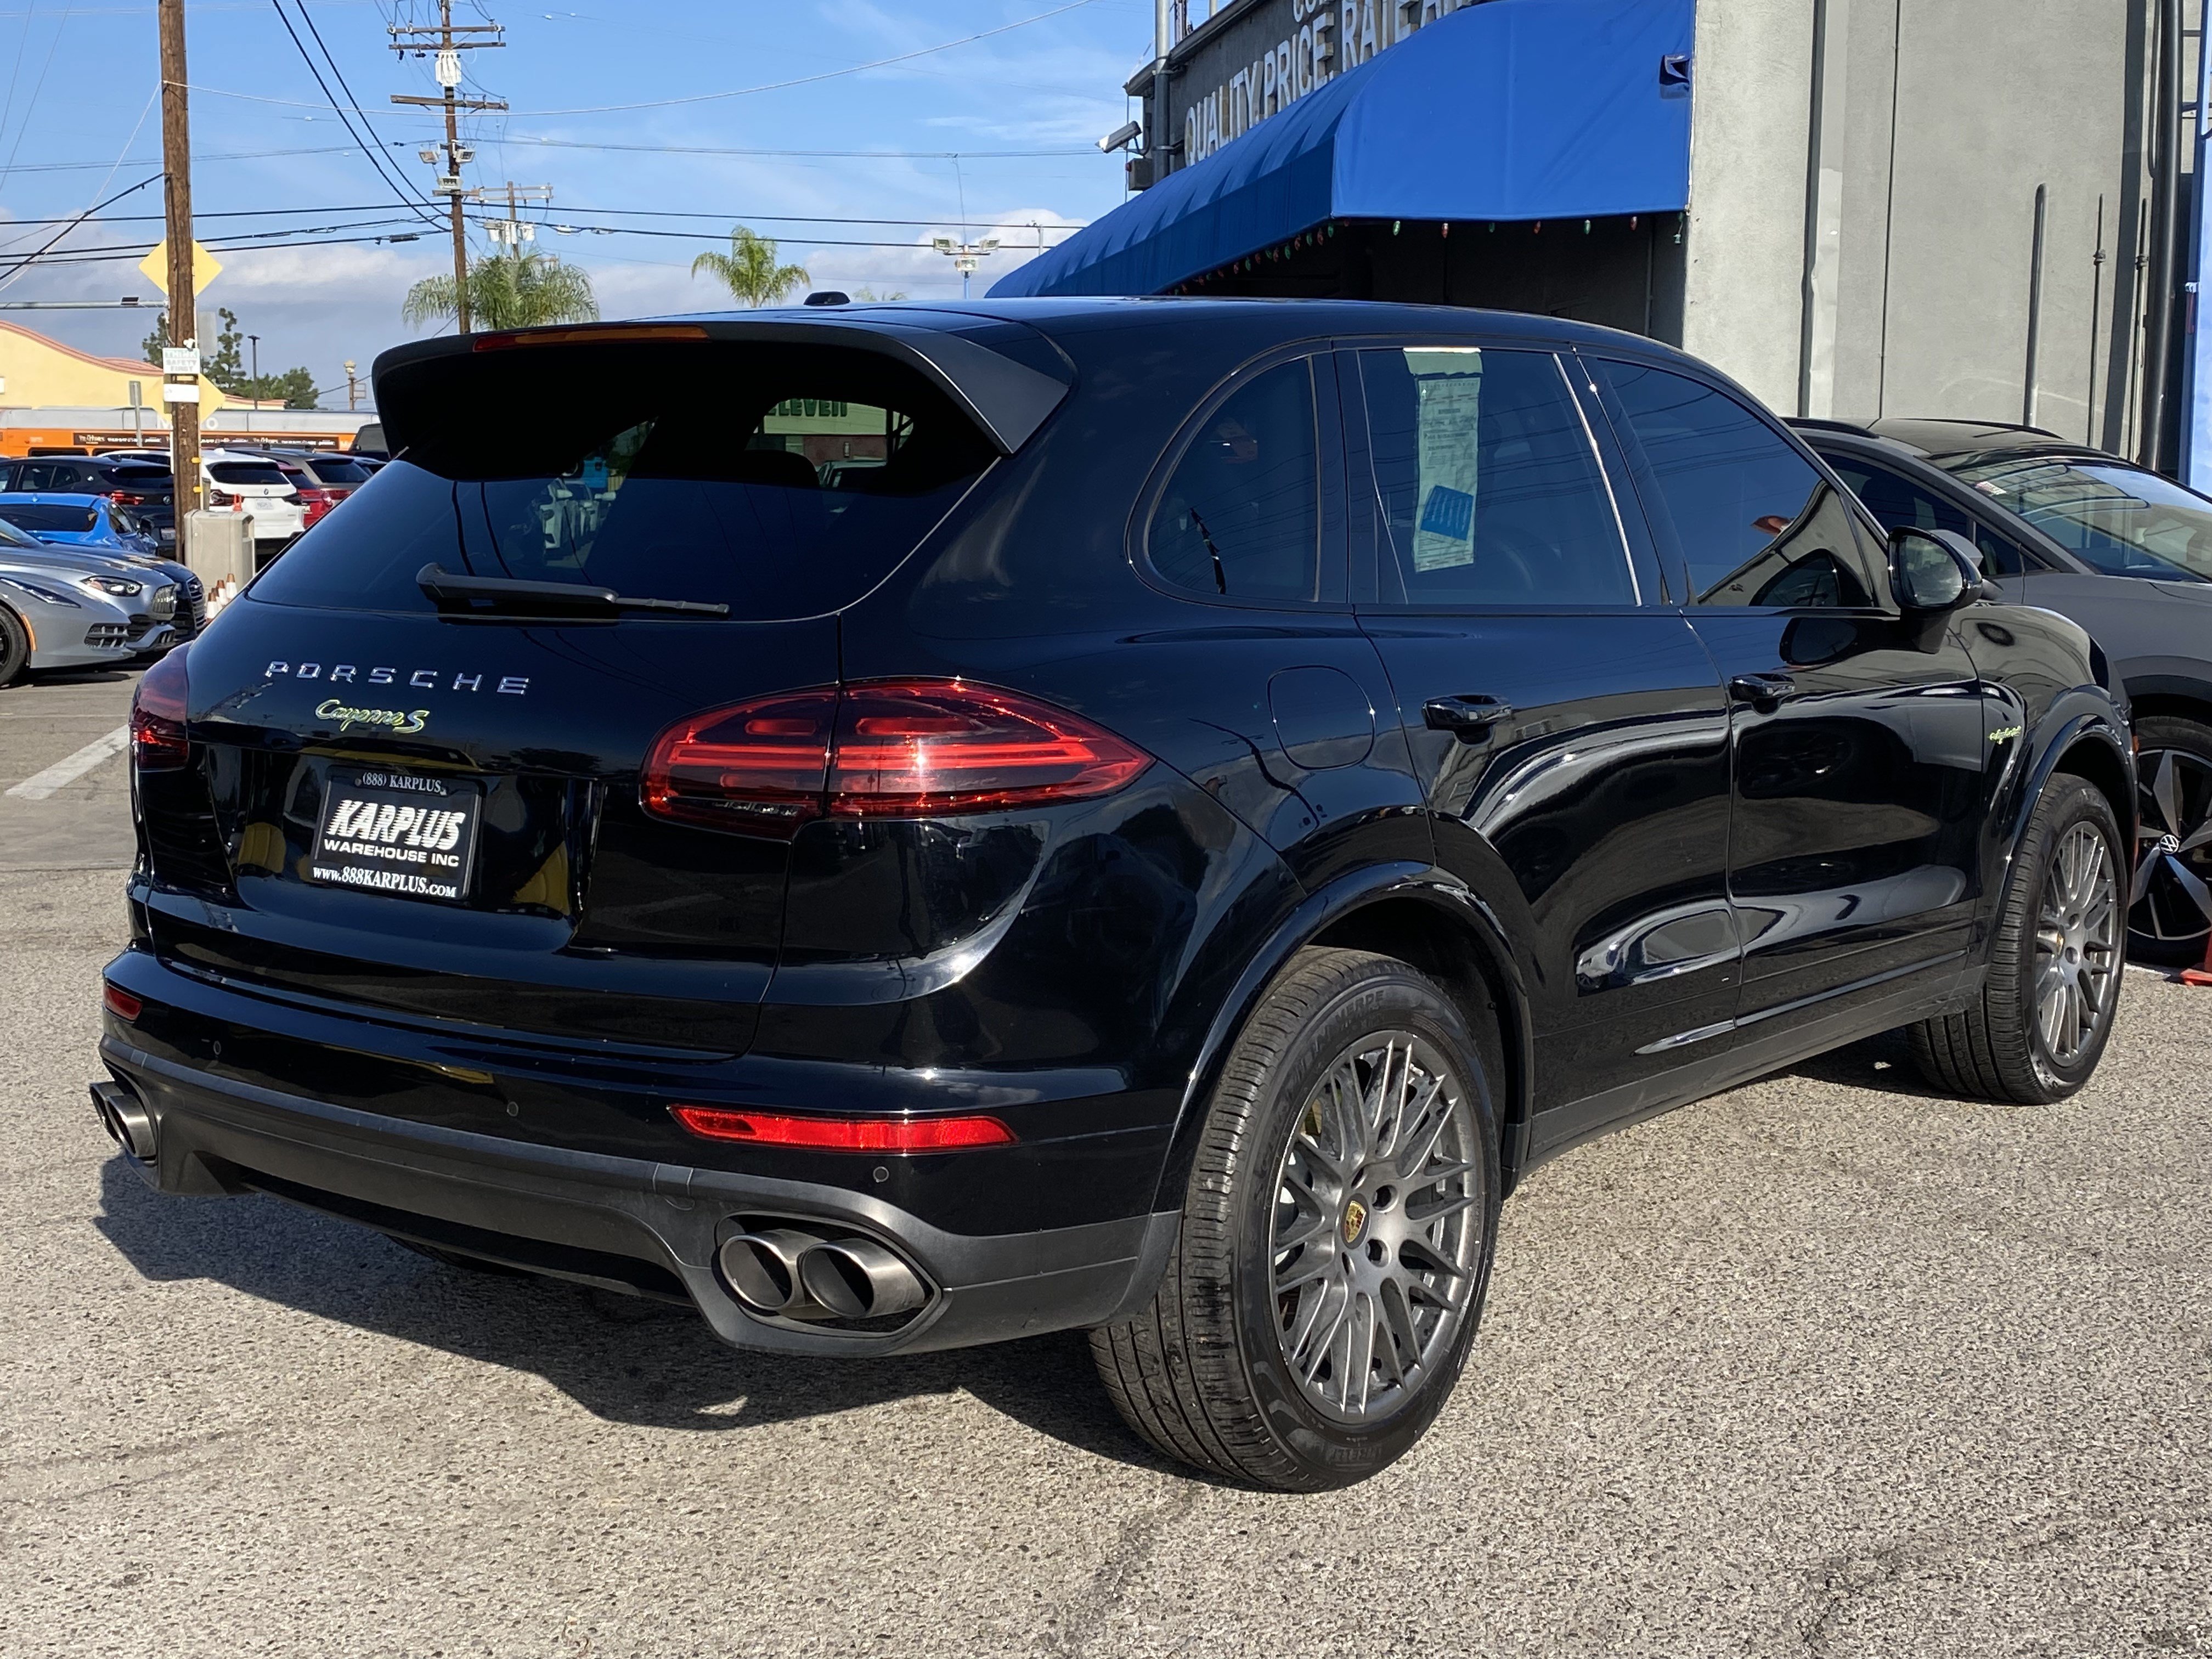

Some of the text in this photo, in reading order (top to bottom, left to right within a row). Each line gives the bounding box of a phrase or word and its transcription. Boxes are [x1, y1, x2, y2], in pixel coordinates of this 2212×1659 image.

[265, 661, 530, 695] PORSCHE
[315, 699, 430, 733] Cayenne S
[363, 772, 442, 793] (888) KARPLUS
[326, 799, 466, 850] KARPLUS
[324, 839, 459, 867] WAREHOUSE INC
[2160, 834, 2179, 855] VW
